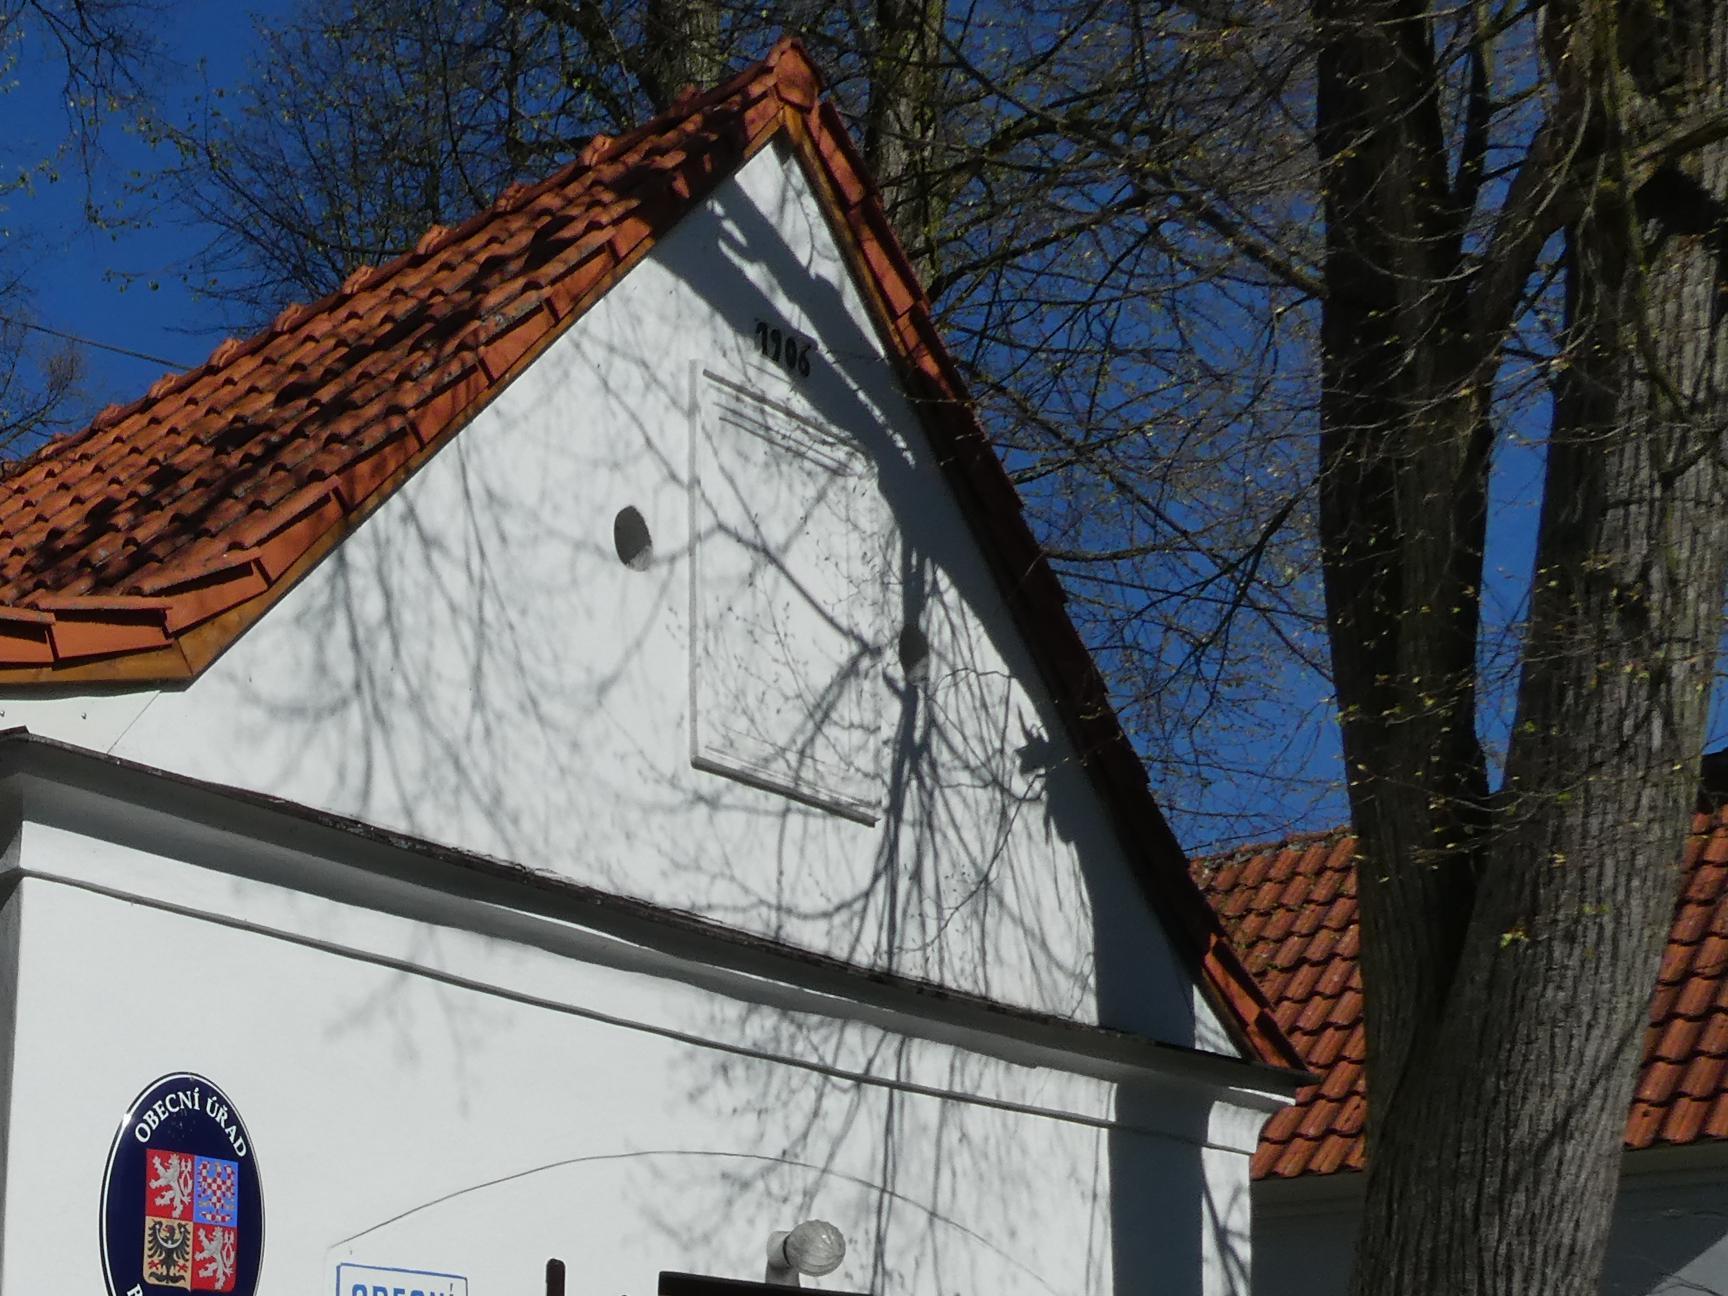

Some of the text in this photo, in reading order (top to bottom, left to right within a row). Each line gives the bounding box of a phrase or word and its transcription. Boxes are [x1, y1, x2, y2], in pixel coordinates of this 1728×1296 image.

[756, 321, 811, 378] 1906
[134, 1087, 247, 1157] OBECNÍ ÚŘAD
